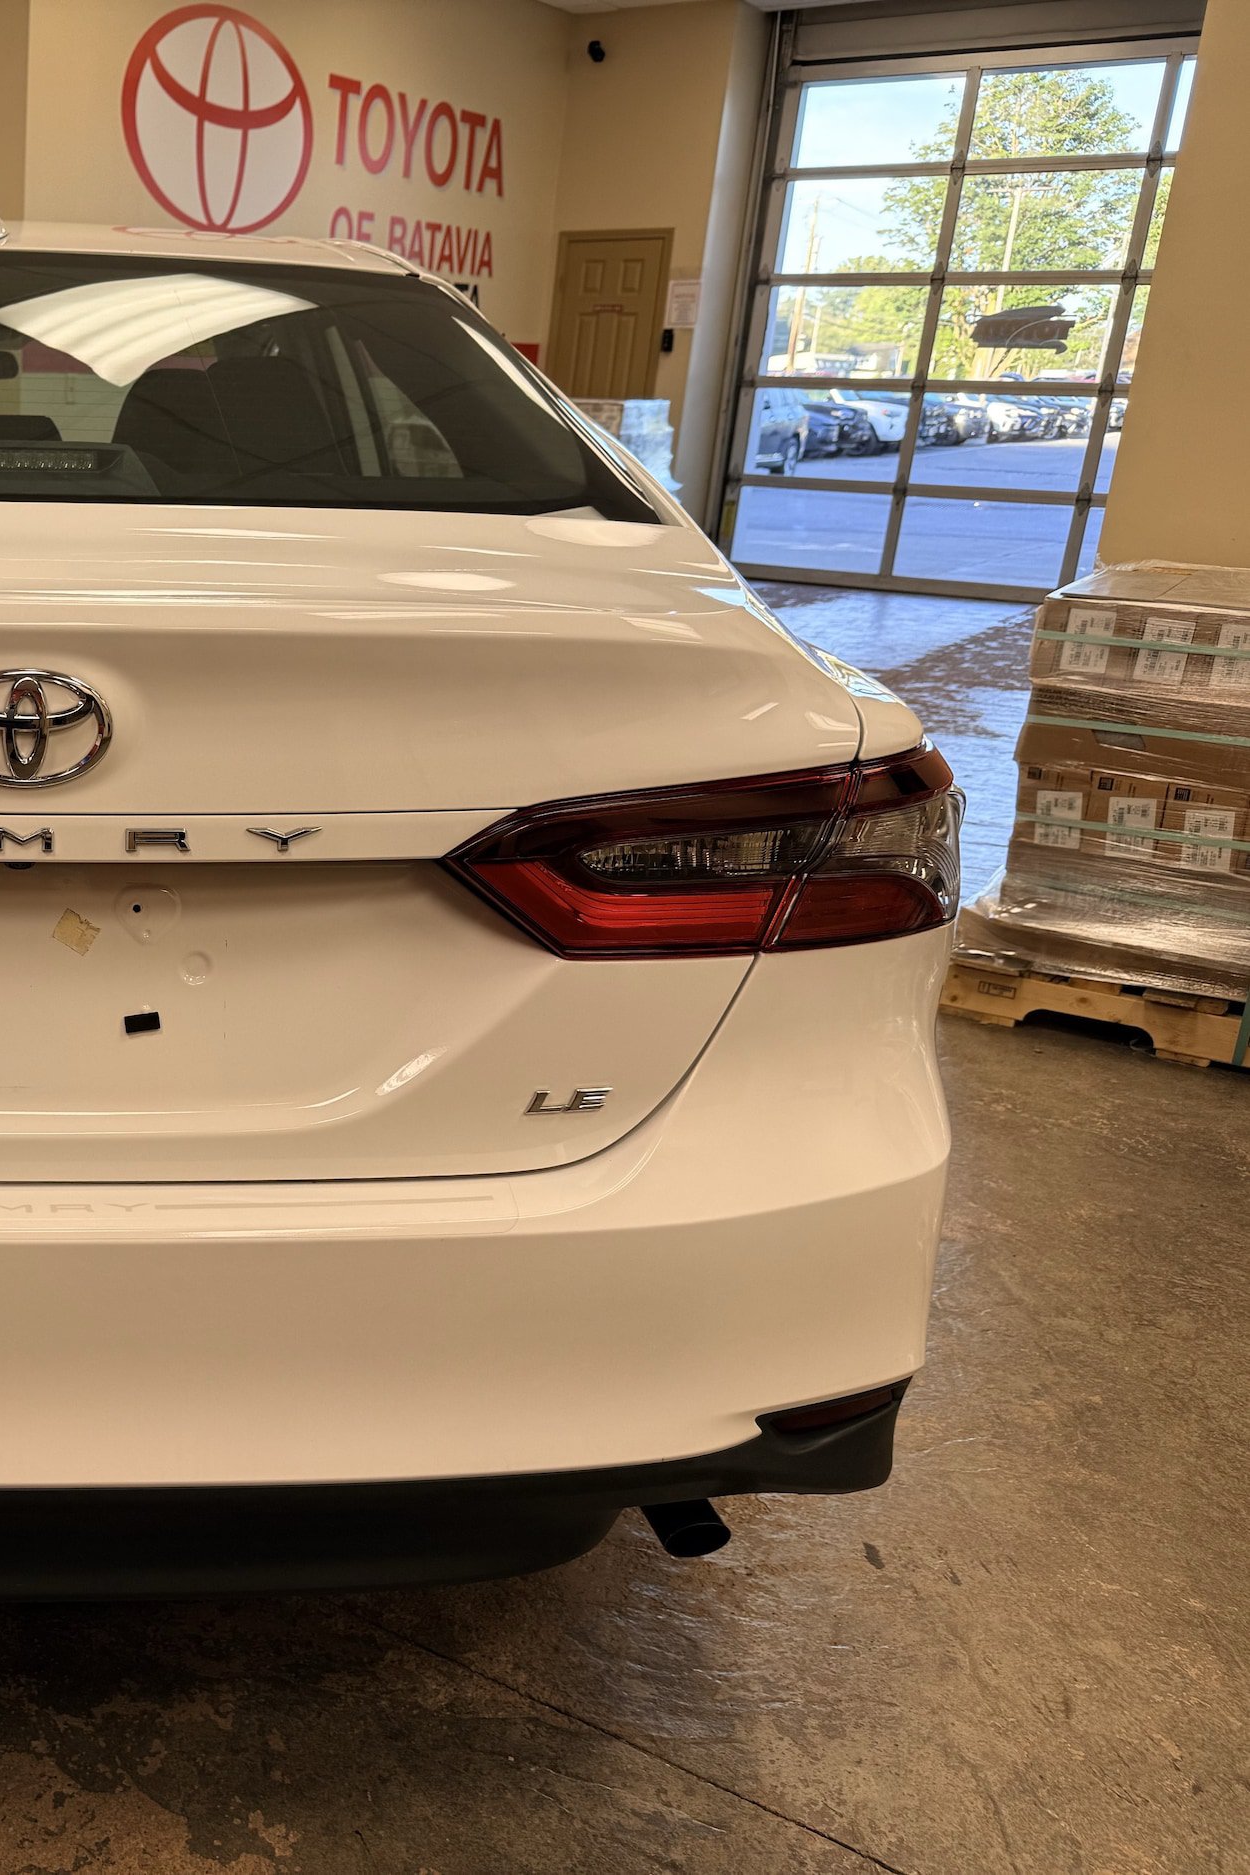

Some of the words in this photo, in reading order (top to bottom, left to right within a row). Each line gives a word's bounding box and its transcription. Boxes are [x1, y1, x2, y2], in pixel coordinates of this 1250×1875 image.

[328, 73, 504, 197] TOYOTA
[329, 206, 375, 243] OF
[387, 215, 493, 277] BATAVIA
[524, 1086, 613, 1115] LE
